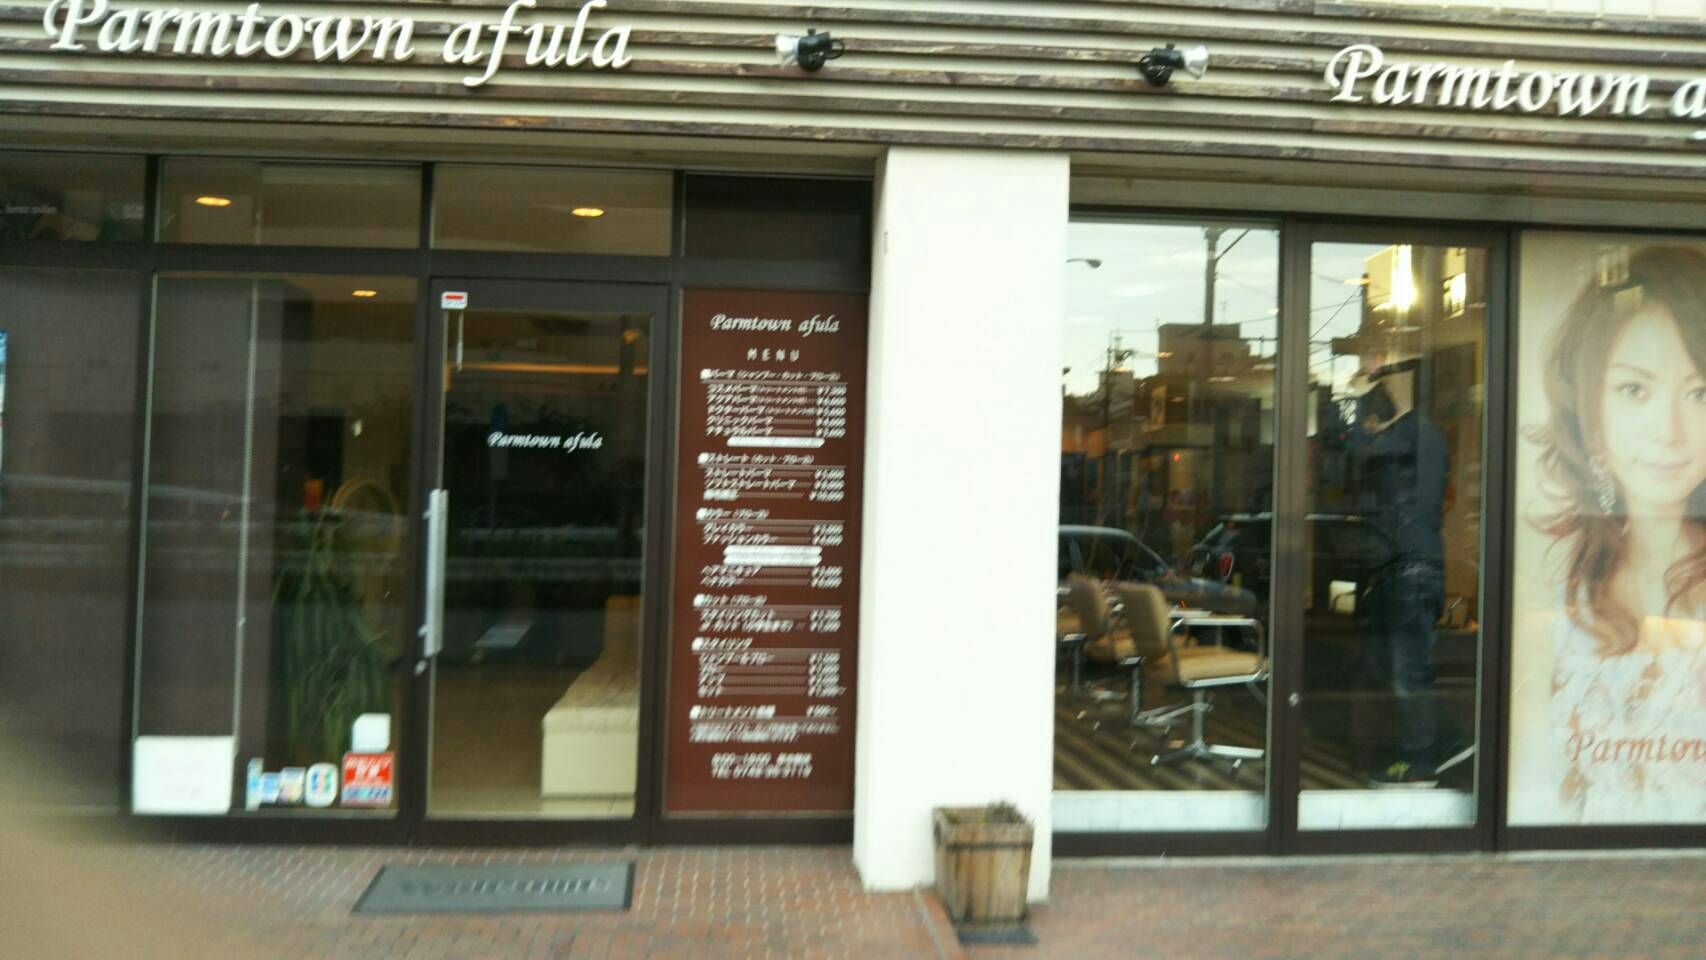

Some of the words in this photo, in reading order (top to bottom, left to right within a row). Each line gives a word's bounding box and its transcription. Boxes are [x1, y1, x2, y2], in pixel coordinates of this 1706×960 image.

[44, 0, 414, 61] Parmtown
[443, 0, 633, 88] afula
[1324, 43, 1651, 118] Parmtown
[710, 313, 791, 332] Parmtown
[798, 314, 841, 337] afula
[486, 430, 561, 449] Parmtown
[564, 431, 603, 453] afula
